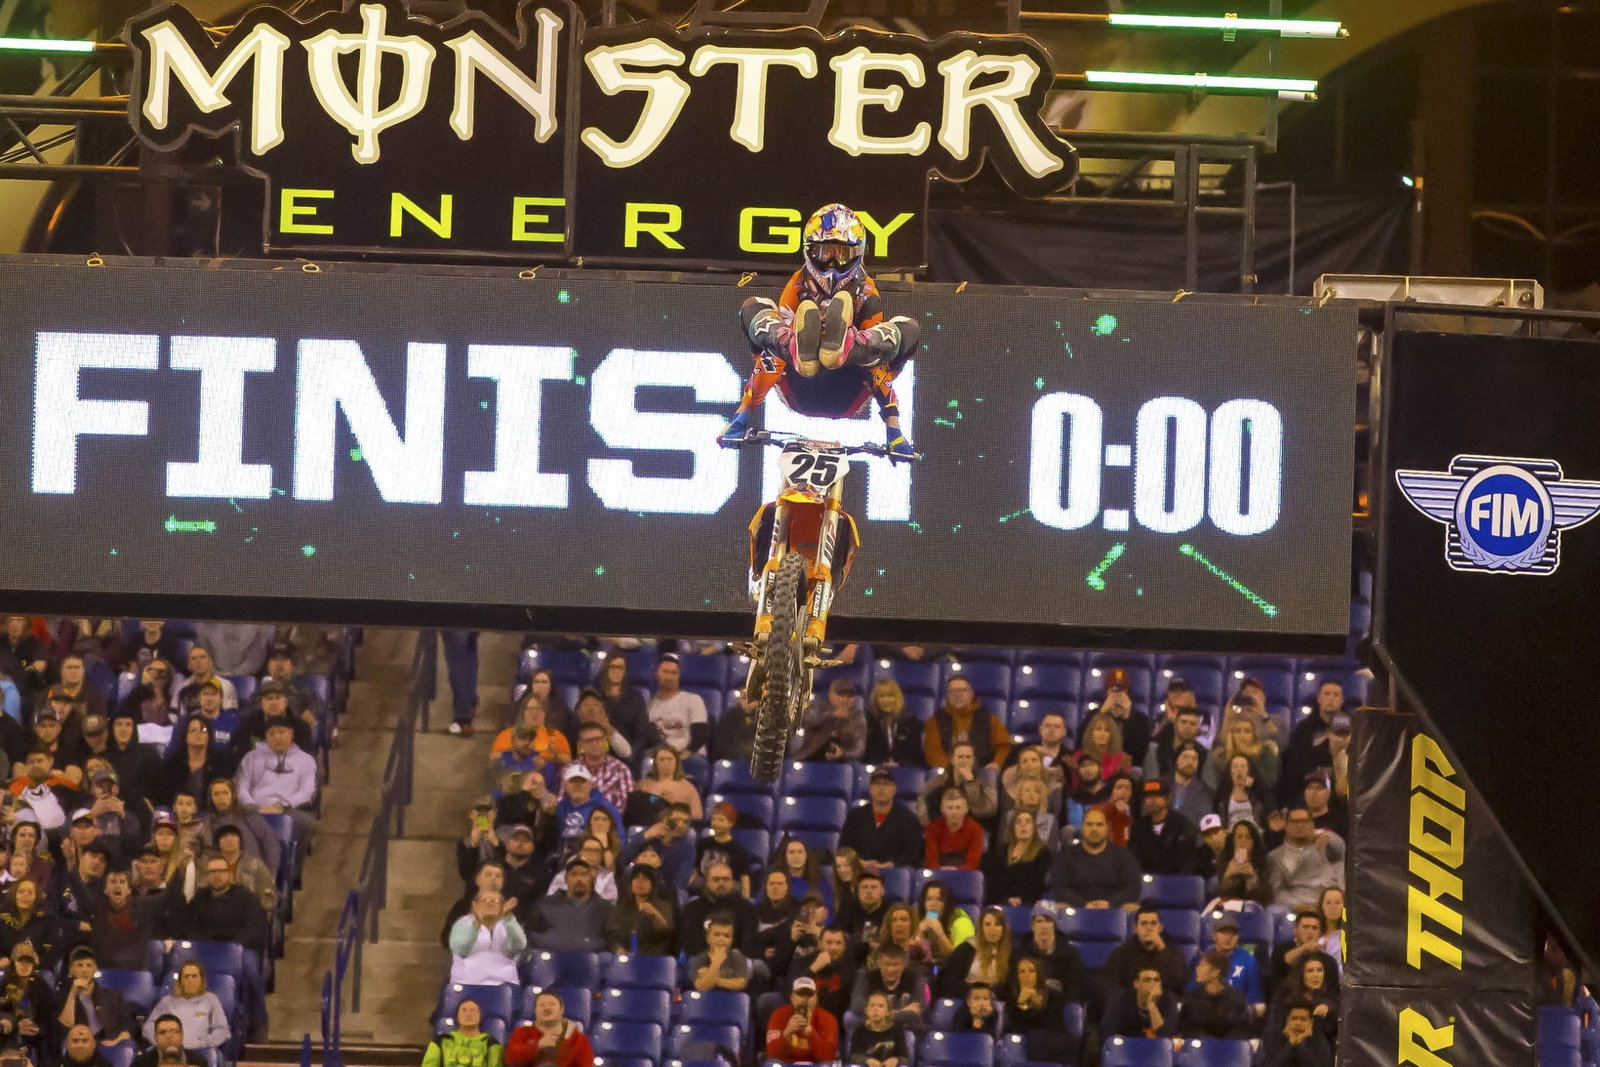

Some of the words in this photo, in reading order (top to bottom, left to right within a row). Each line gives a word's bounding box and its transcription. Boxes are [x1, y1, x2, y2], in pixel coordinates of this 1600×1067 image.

[138, 3, 1066, 180] MONSTER
[279, 188, 914, 258] ENERGY
[31, 331, 915, 522] FINISH
[1028, 391, 1283, 536] 0:00
[788, 453, 840, 487] 25
[1471, 493, 1539, 538] FIM
[1406, 733, 1466, 971] THOR
